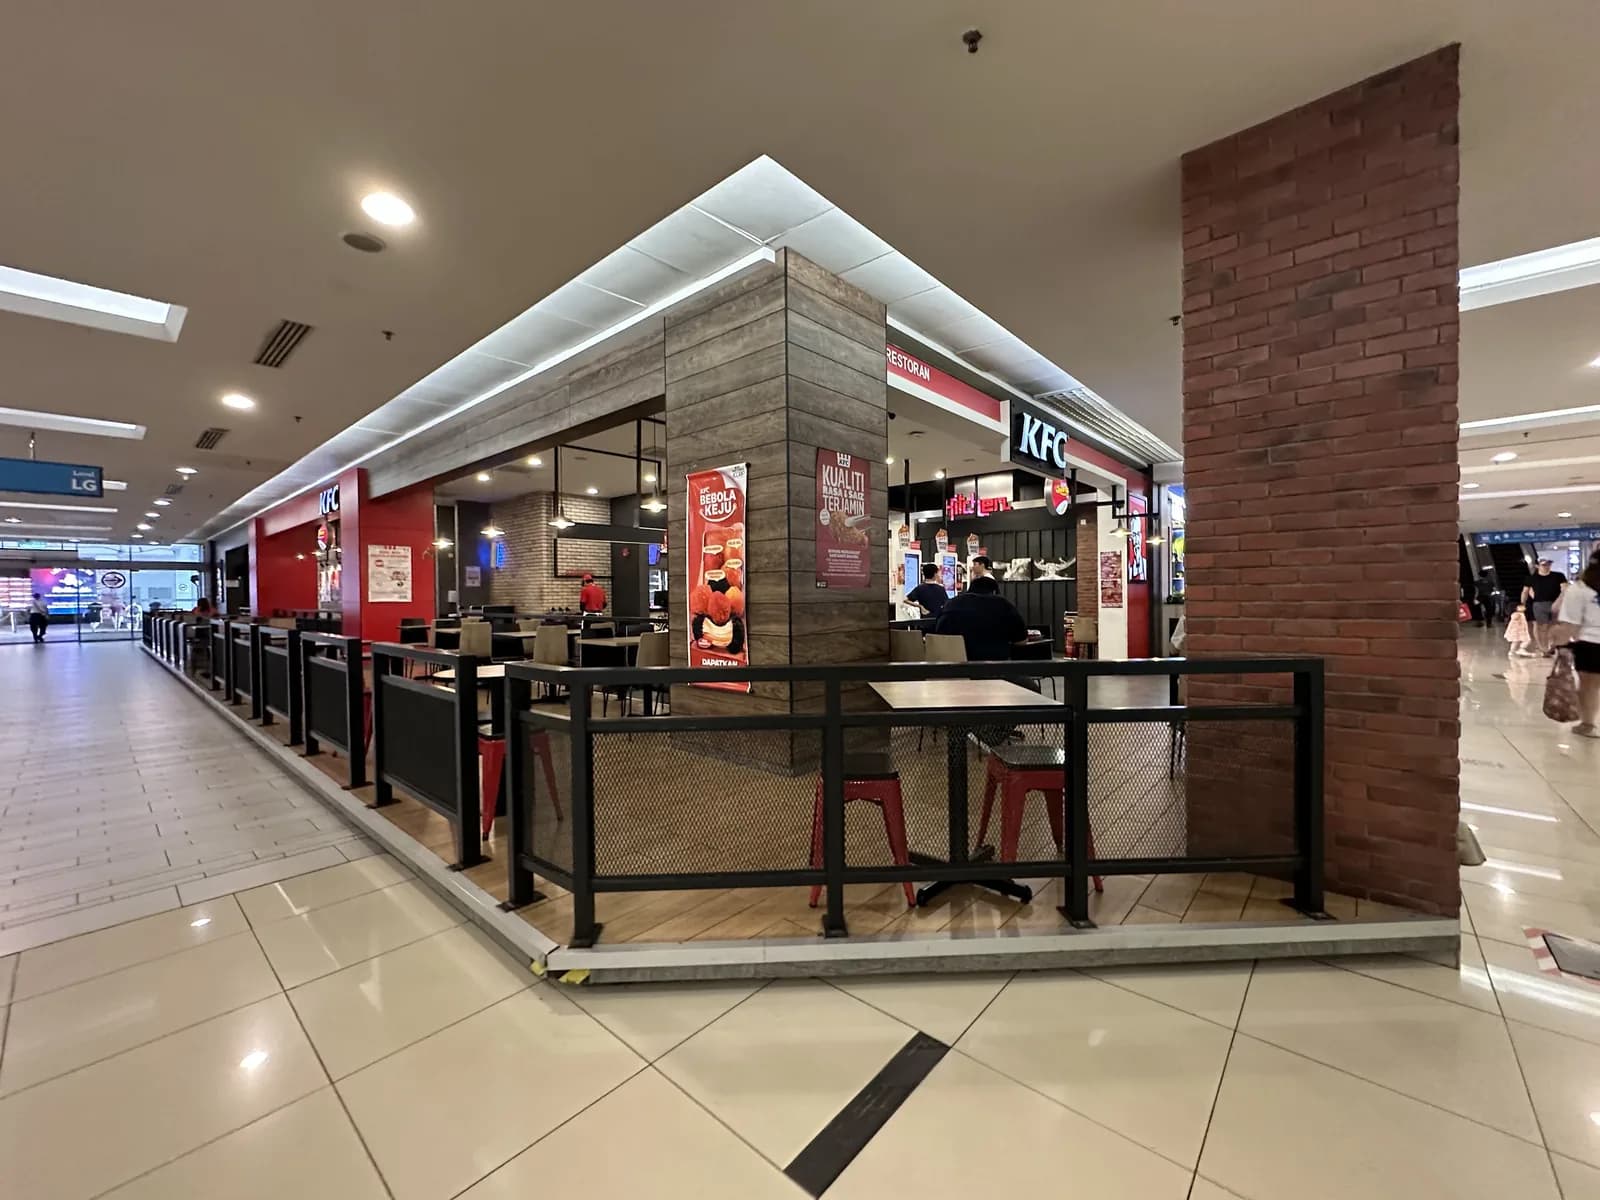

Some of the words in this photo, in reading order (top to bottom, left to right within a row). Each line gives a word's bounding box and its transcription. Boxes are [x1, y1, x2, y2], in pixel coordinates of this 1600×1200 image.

[886, 347, 930, 381] RESTORAN
[1019, 412, 1068, 469] KFC
[72, 479, 97, 491] LG
[822, 464, 864, 492] KUALITI
[320, 485, 339, 515] KFC
[700, 490, 736, 506] BEBOLA
[823, 486, 843, 498] RASA
[704, 502, 732, 516] KEJU
[823, 496, 864, 516] TERJAMIN
[702, 658, 738, 667] DAPATKAN
